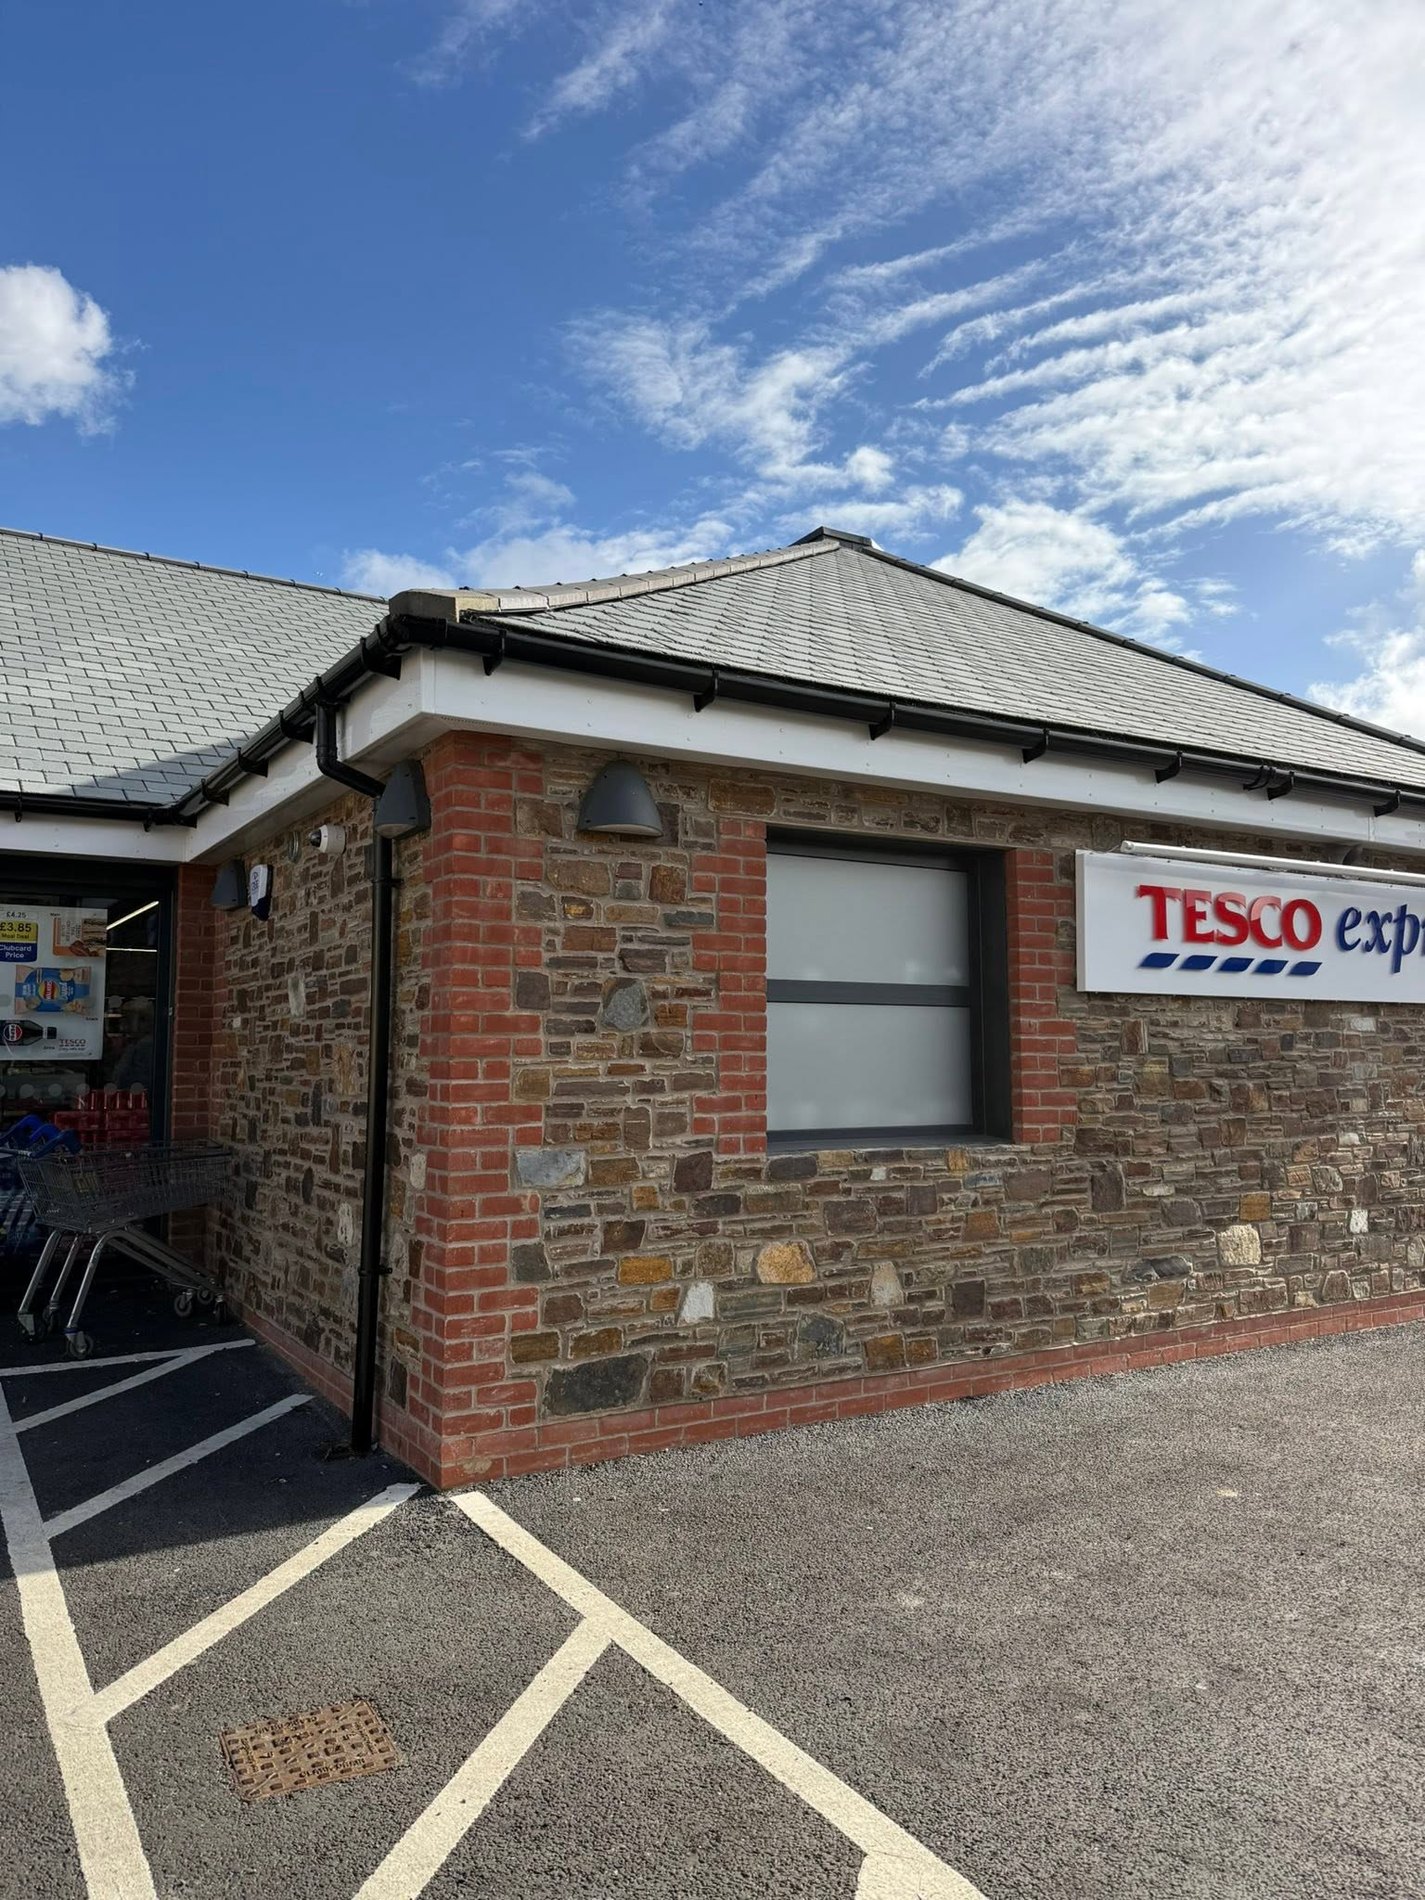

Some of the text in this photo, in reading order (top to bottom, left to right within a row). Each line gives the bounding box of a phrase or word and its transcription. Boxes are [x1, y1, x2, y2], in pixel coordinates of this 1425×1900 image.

[6, 911, 27, 919] £4.25
[1137, 884, 1322, 951] TESCO
[0, 921, 32, 933] £3.85
[5, 951, 25, 959] Price
